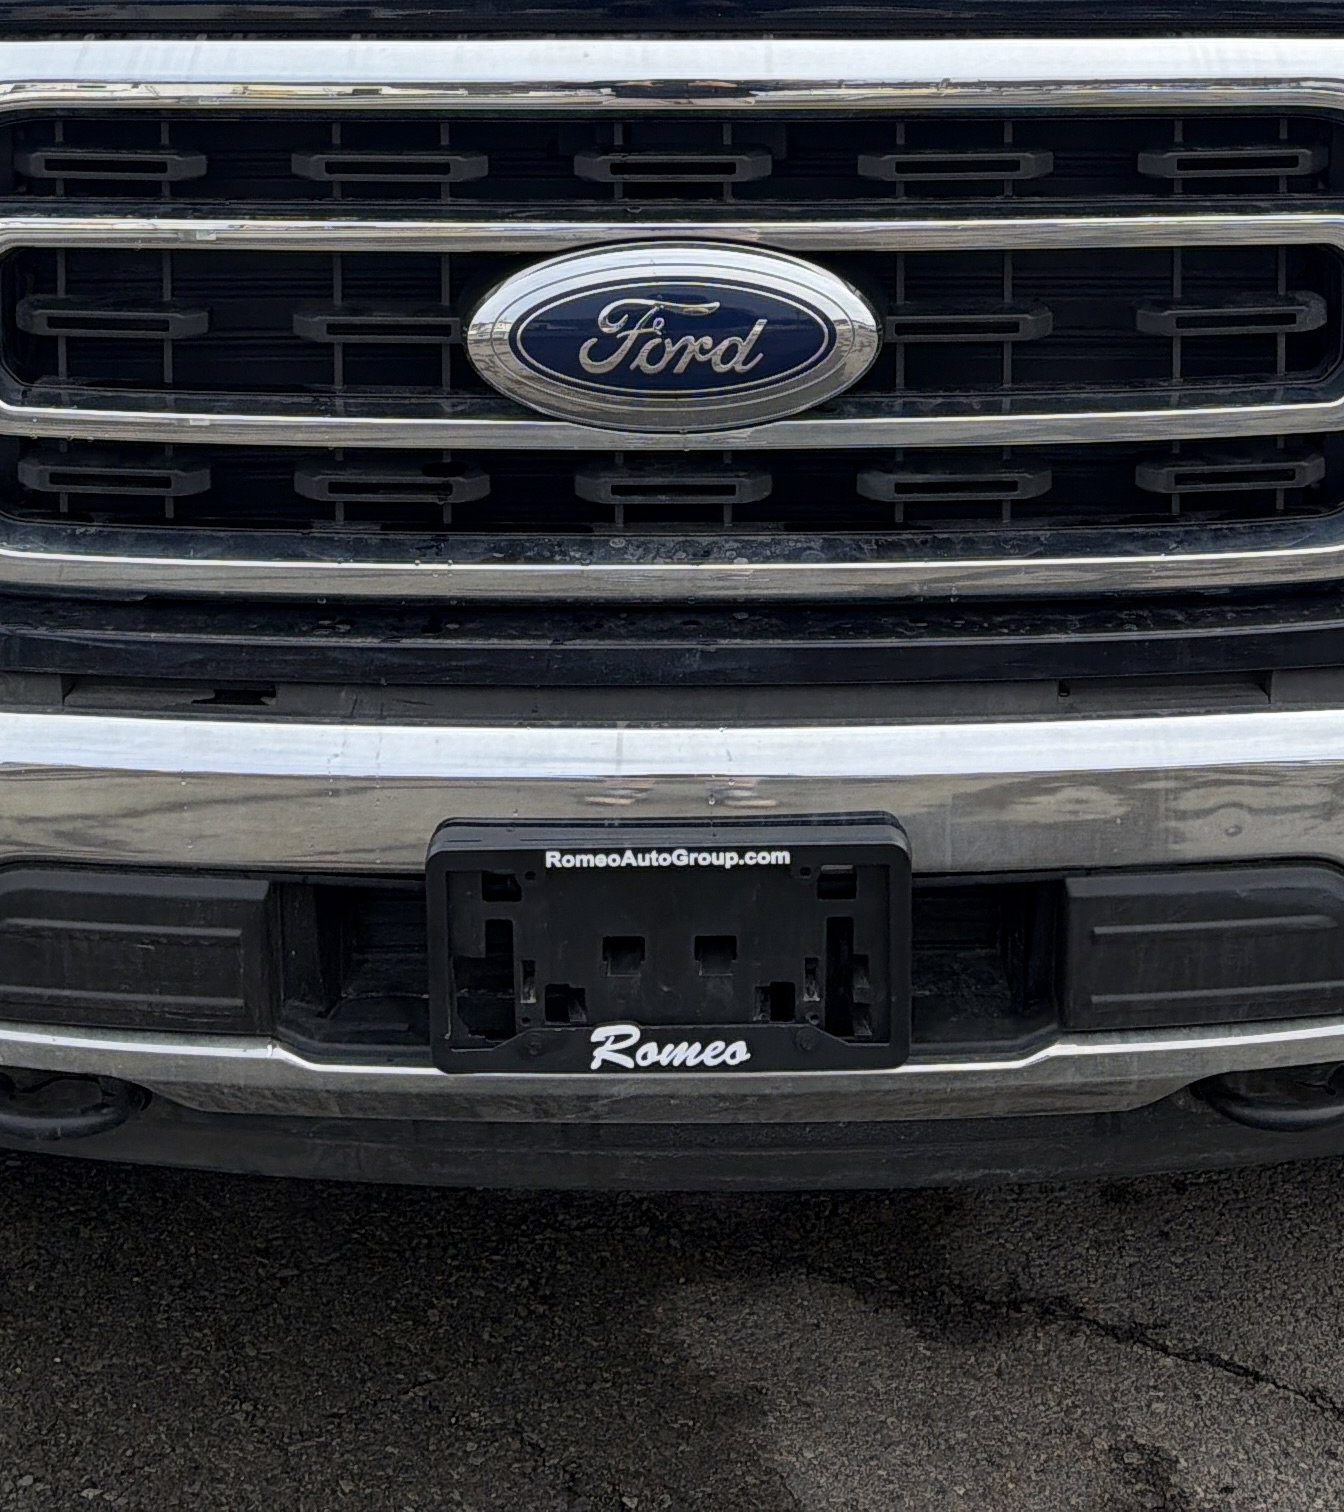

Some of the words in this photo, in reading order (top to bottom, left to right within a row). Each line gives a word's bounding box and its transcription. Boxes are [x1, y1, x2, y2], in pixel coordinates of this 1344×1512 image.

[578, 298, 768, 375] Ford
[545, 849, 792, 870] RomeoAutoGroup.com
[589, 1024, 752, 1071] Romeo
